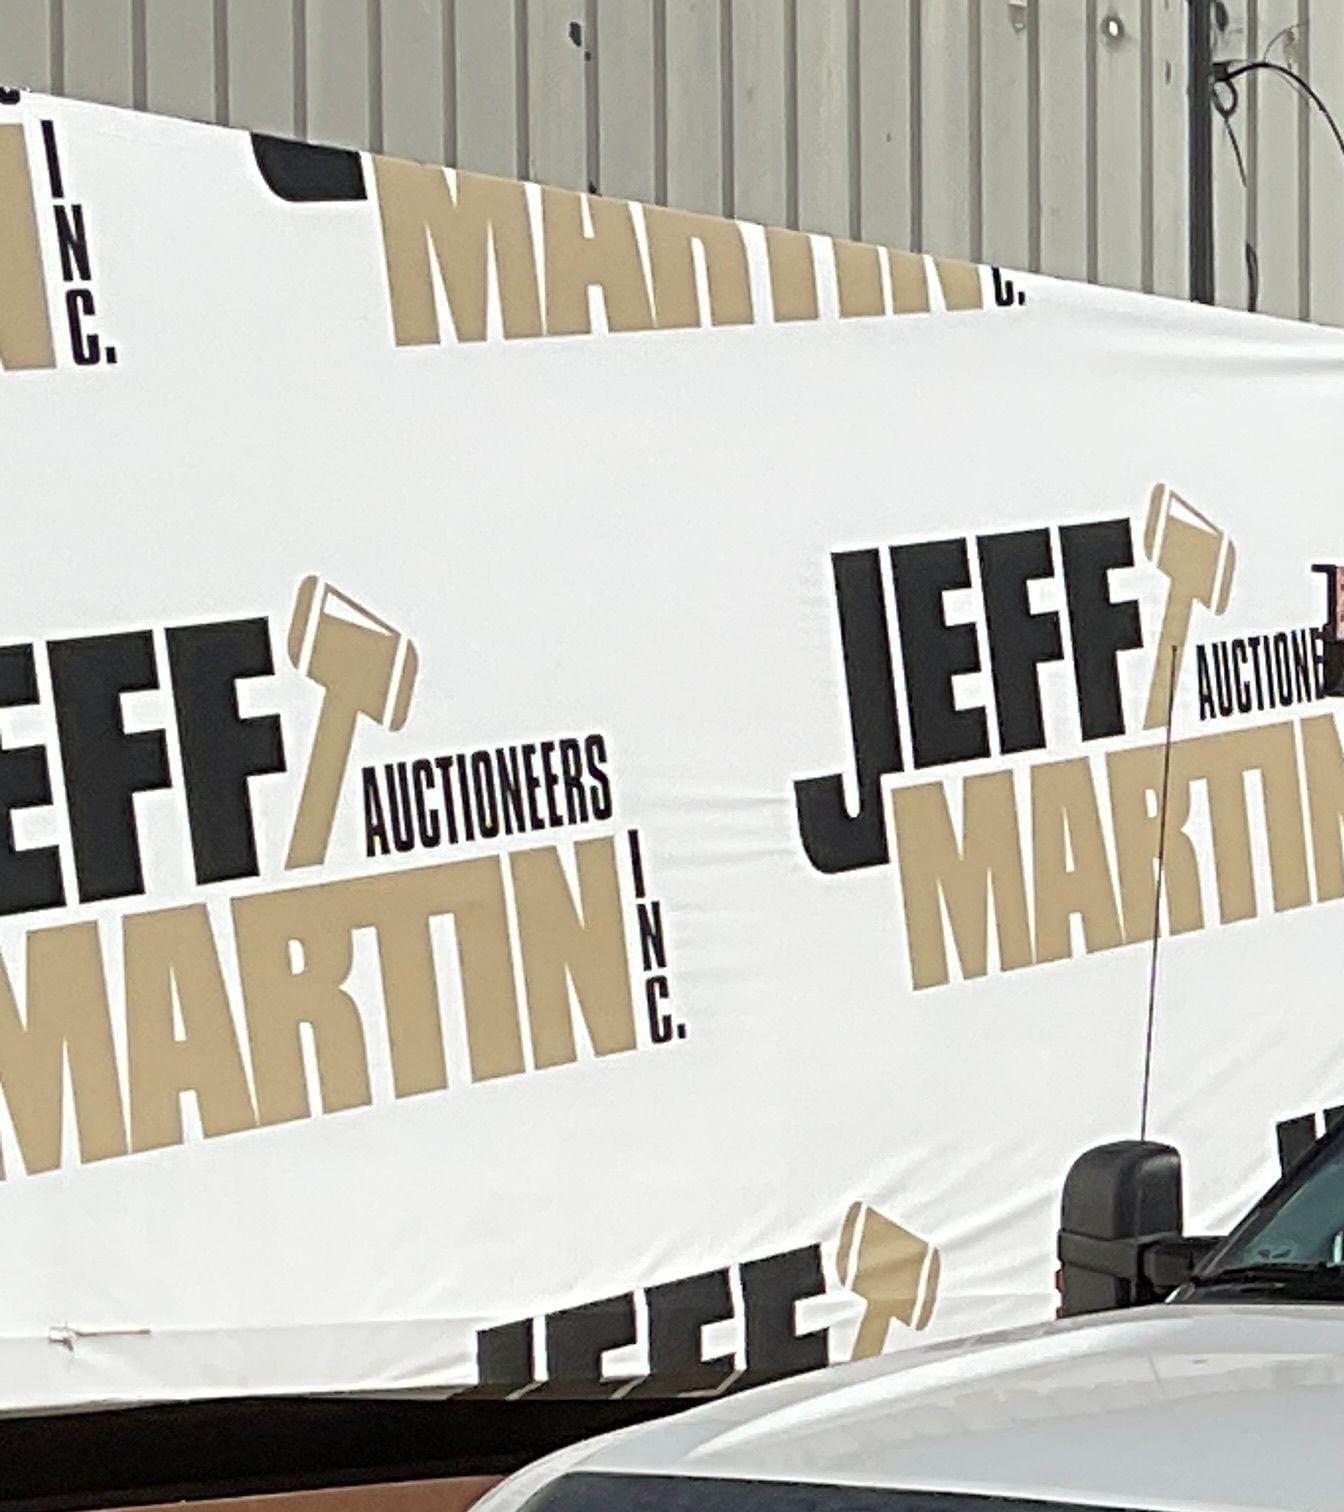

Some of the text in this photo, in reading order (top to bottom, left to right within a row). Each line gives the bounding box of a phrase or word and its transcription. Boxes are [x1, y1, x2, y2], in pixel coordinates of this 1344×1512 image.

[40, 119, 117, 366] INC.
[362, 734, 613, 858] AUCTIONEERS
[794, 517, 1143, 875] JEFF
[0, 835, 638, 1181] MARTIN
[626, 829, 687, 1044] INC.
